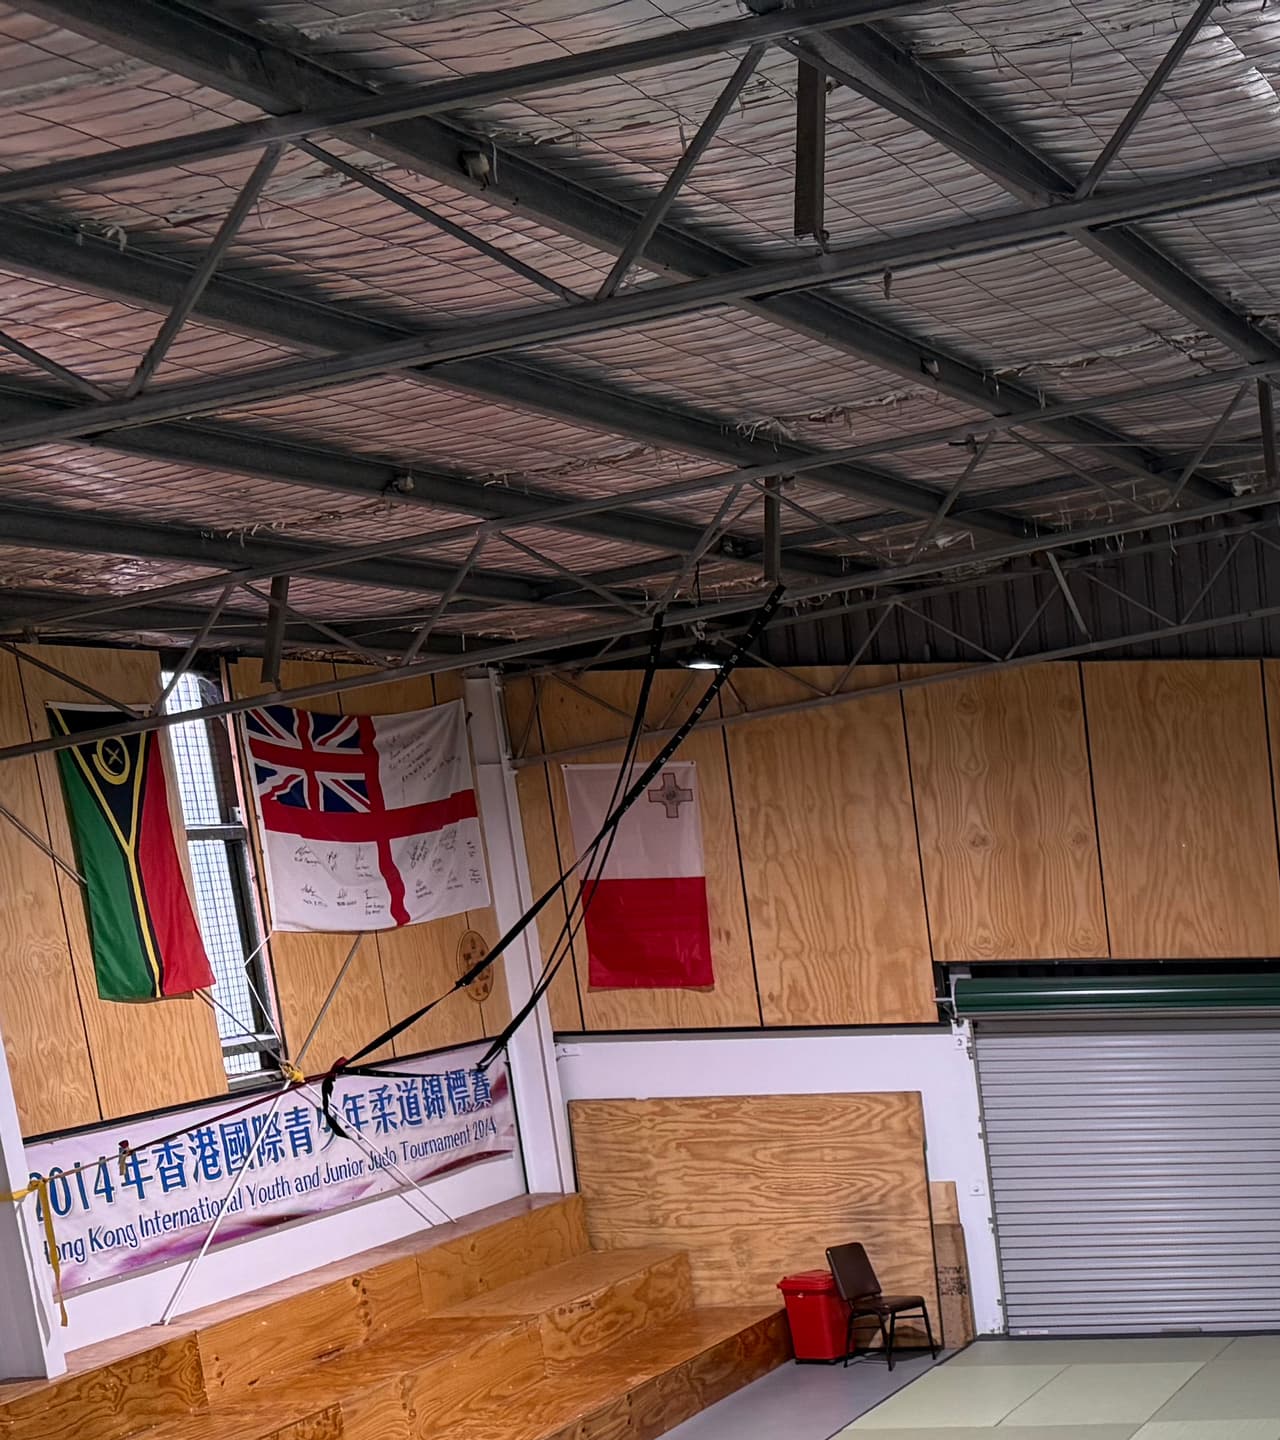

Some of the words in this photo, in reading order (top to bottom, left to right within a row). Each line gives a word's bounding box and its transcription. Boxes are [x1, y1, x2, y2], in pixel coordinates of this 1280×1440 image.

[88, 1222, 138, 1249] Kong
[139, 1188, 243, 1237] International
[246, 1174, 291, 1207] Youth
[295, 1166, 320, 1192] and
[323, 1156, 365, 1184] Junior
[368, 1148, 397, 1171] Judo
[400, 1127, 471, 1160] Tournament
[472, 1118, 497, 1141] 2014
